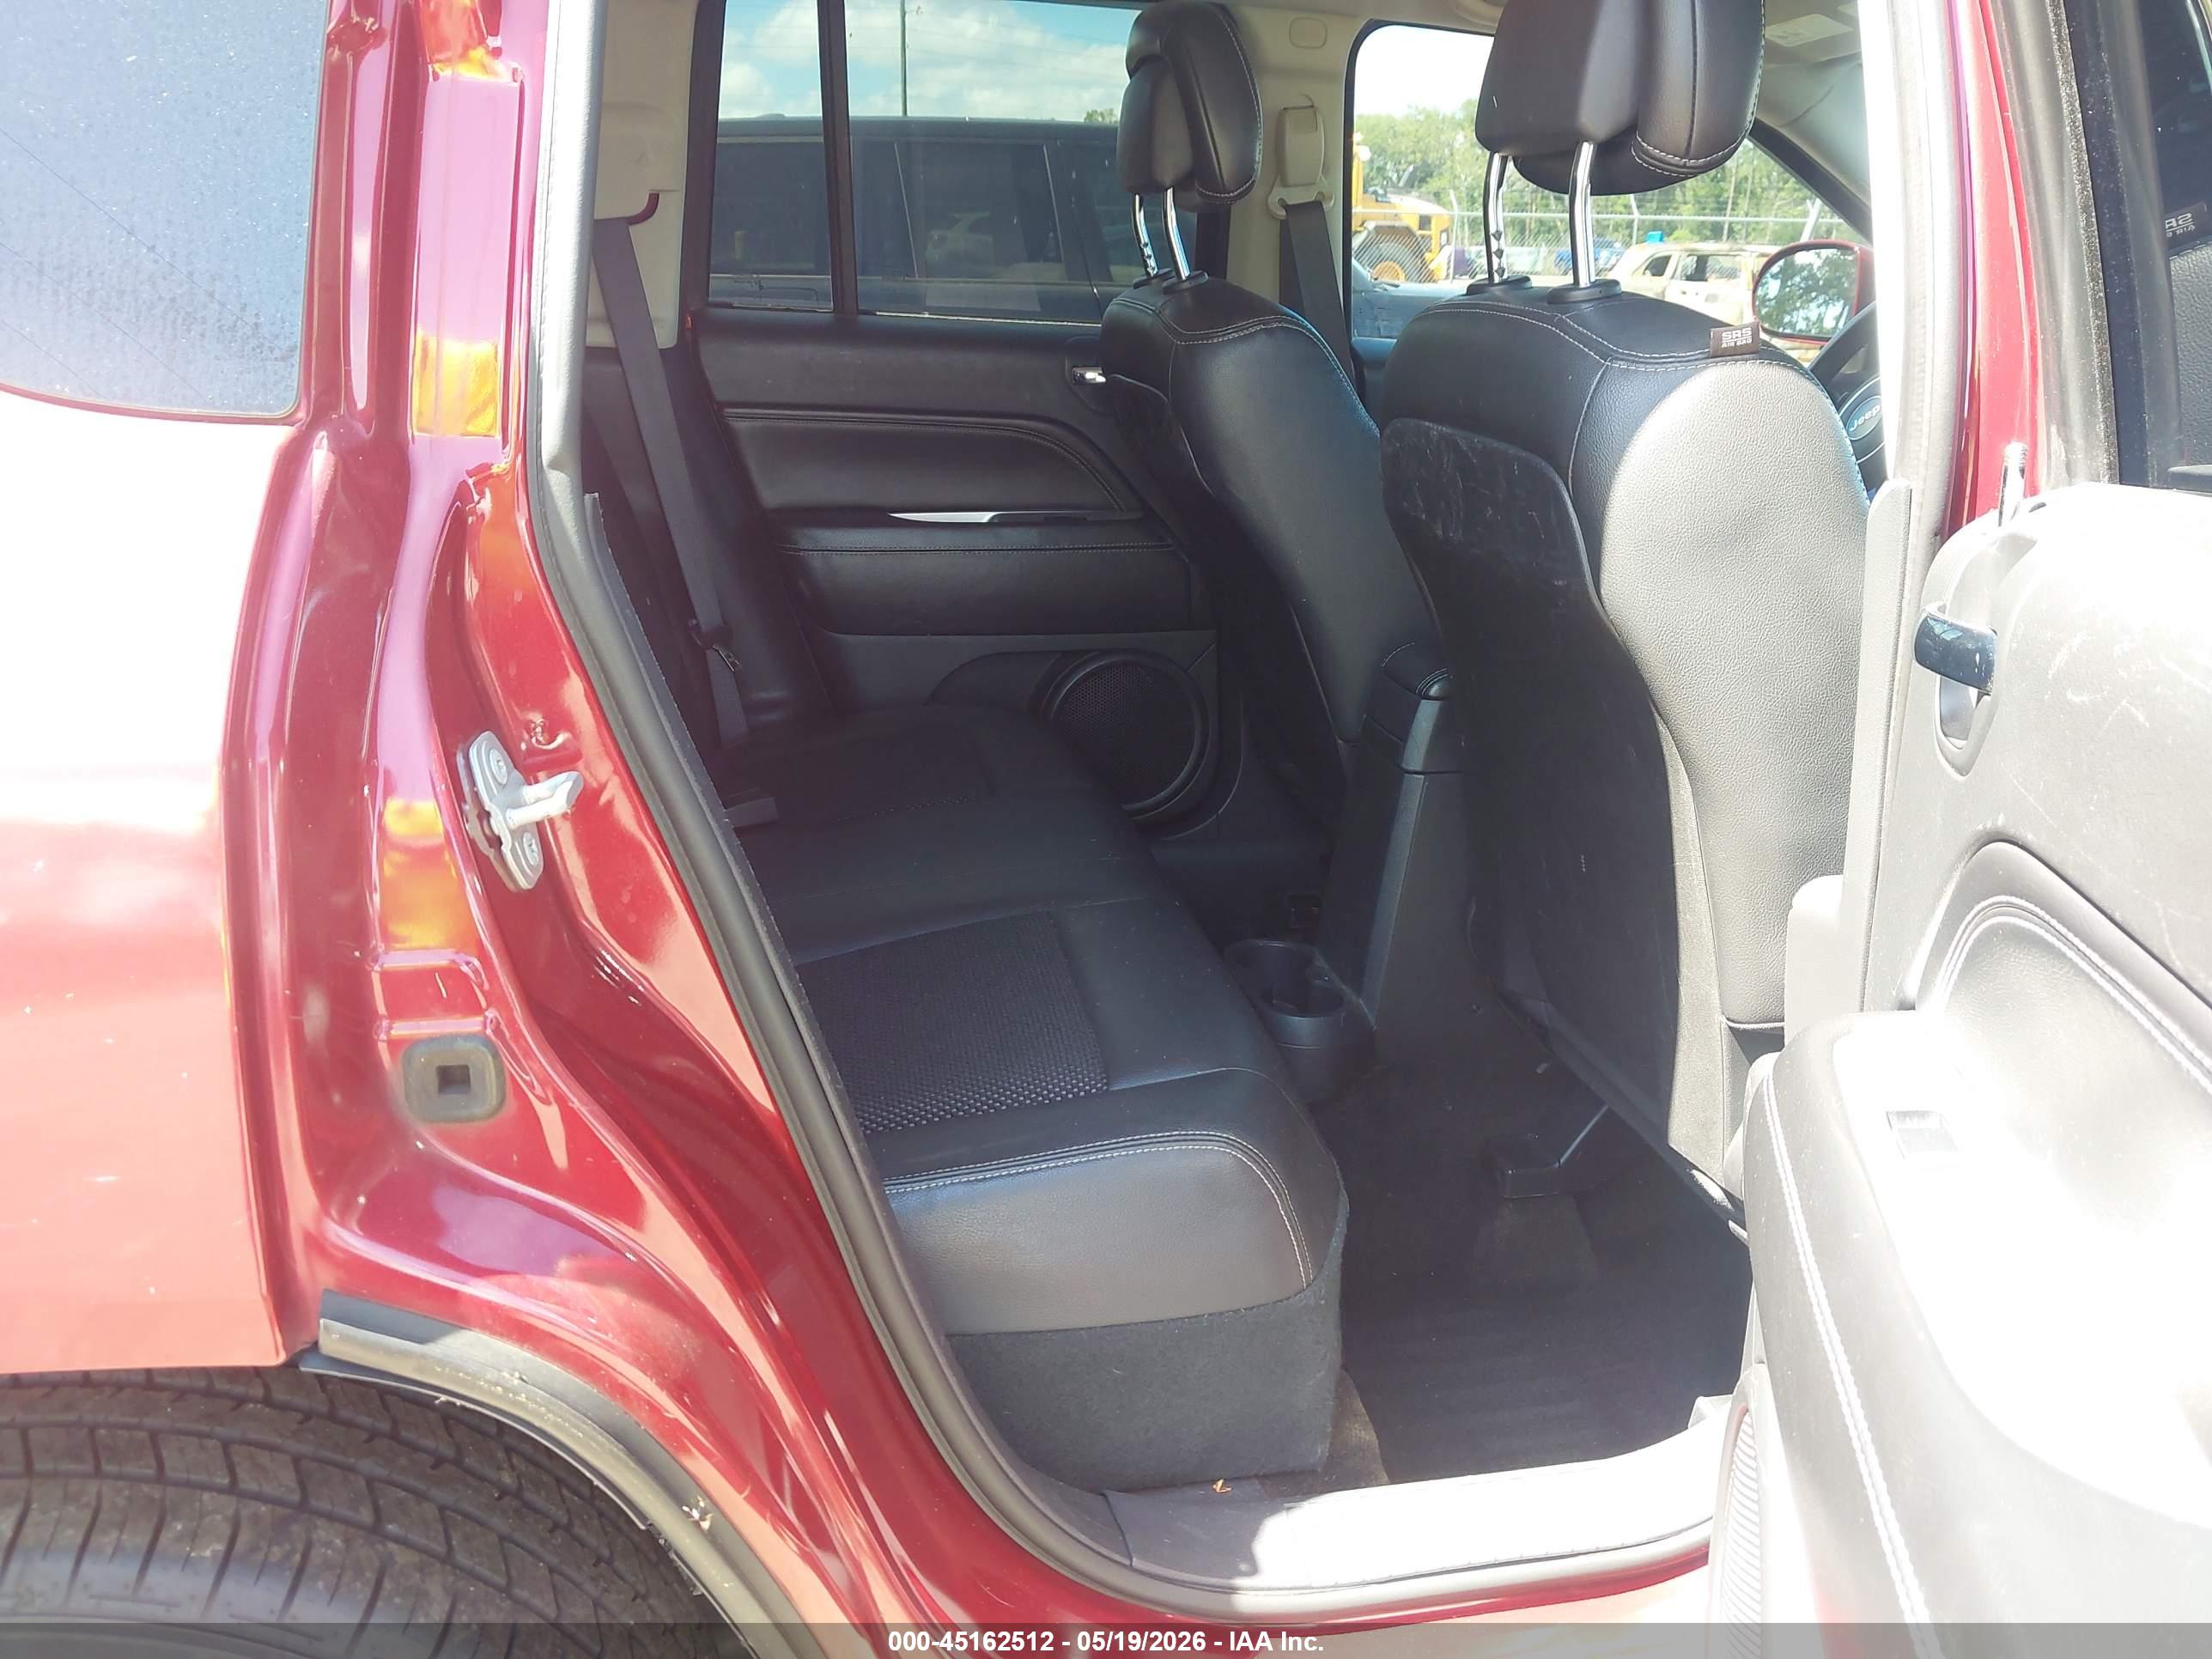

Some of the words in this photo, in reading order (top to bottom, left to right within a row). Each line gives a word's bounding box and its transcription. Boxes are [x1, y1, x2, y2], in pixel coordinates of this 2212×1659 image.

[1722, 327, 1752, 340] SRS
[1736, 337, 1752, 346] BAG
[1849, 404, 1881, 432] Jeep
